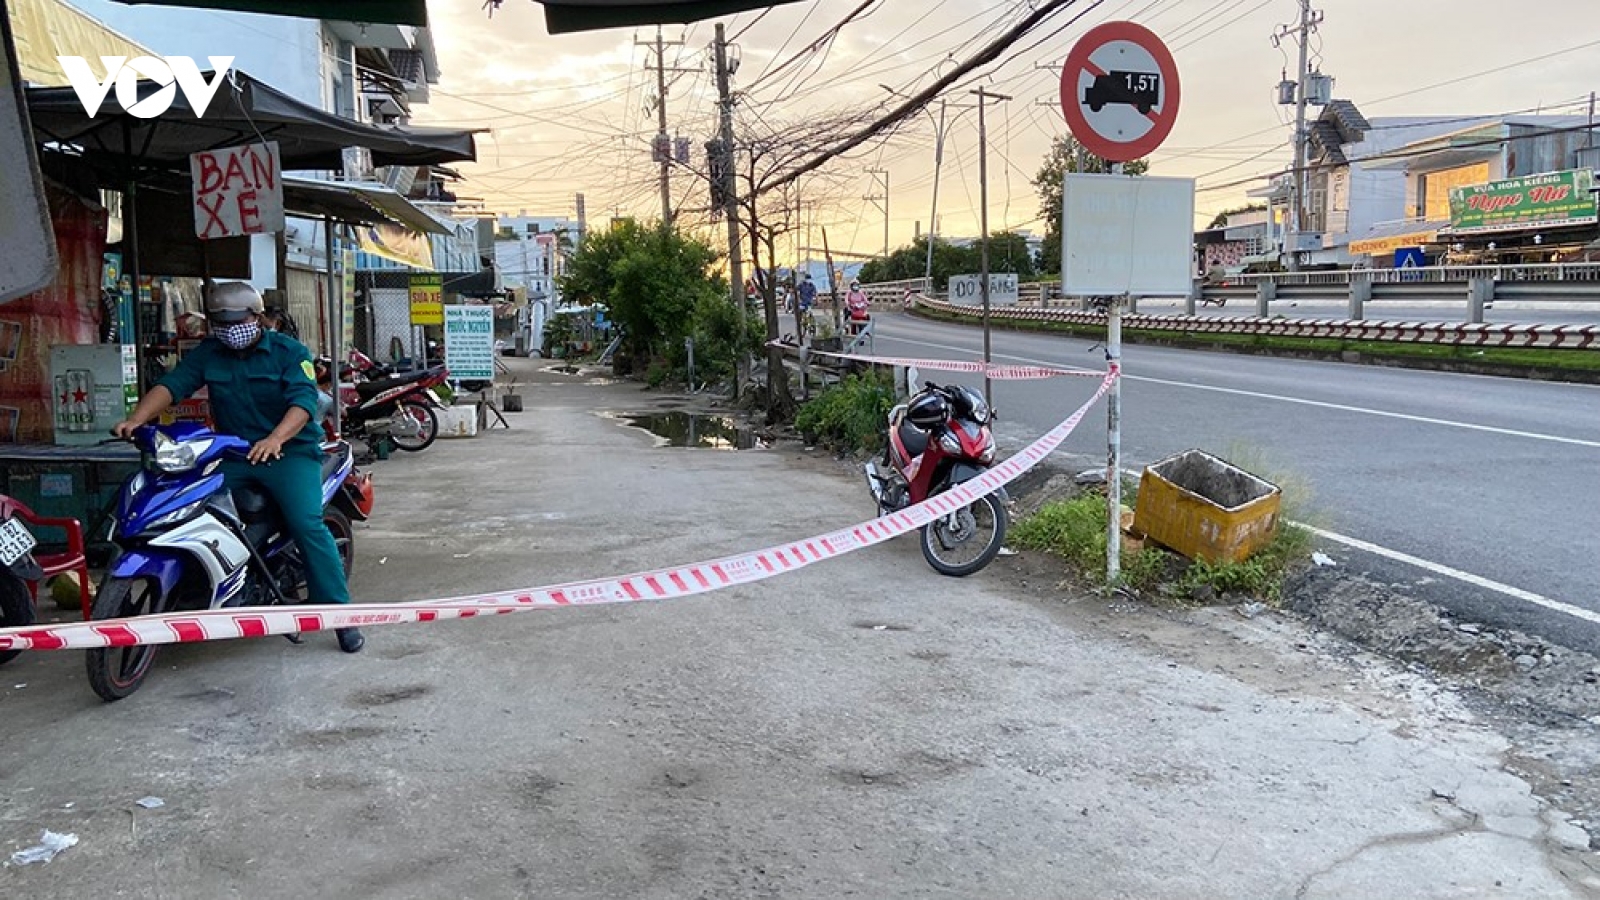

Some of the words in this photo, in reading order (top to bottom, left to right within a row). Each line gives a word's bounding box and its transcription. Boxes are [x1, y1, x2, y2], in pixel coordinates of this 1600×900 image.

[1124, 74, 1158, 93] 1,5T
[197, 144, 274, 195] BÁN
[1498, 181, 1520, 190] HOA
[196, 189, 266, 240] XE
[466, 308, 490, 317] THUỐC
